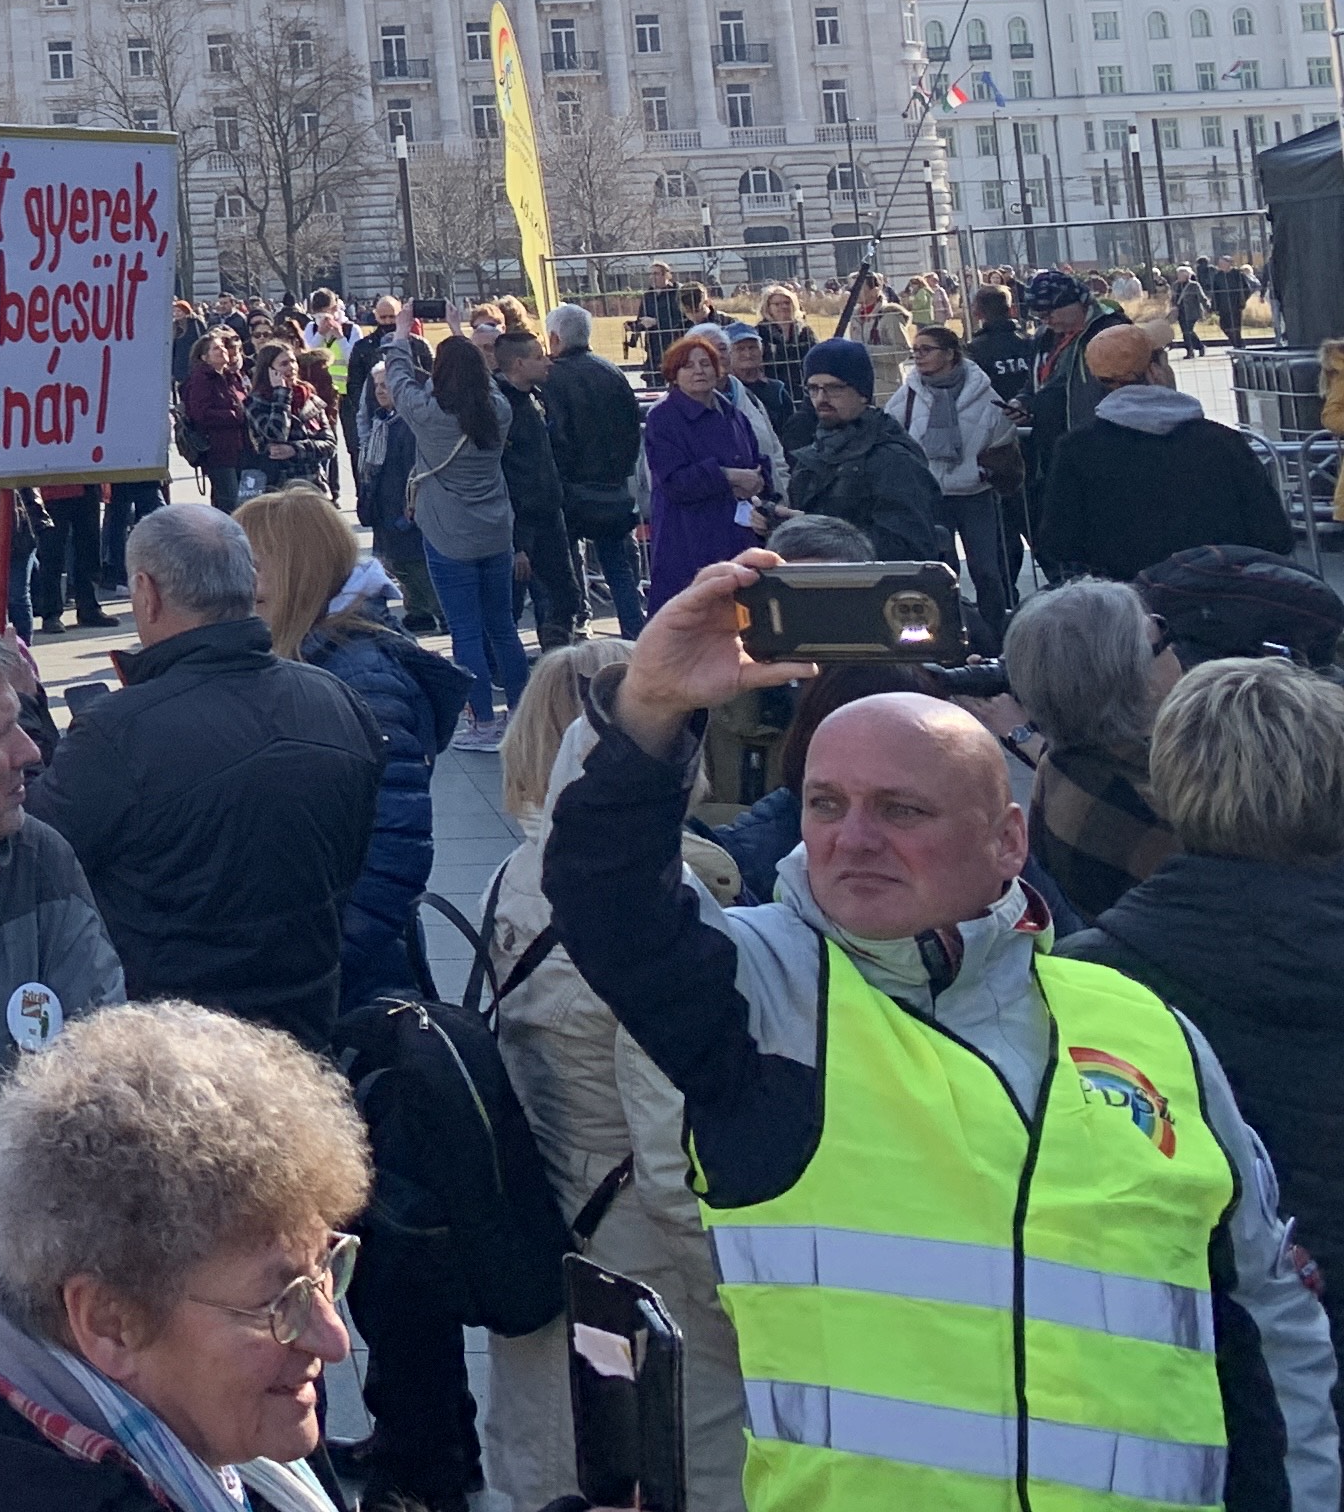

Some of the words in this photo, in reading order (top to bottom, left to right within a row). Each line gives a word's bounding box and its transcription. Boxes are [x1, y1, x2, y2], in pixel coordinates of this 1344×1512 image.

[23, 161, 169, 273] gyerek,
[995, 357, 1029, 375] STA
[1079, 1078, 1176, 1126] PDSZ
